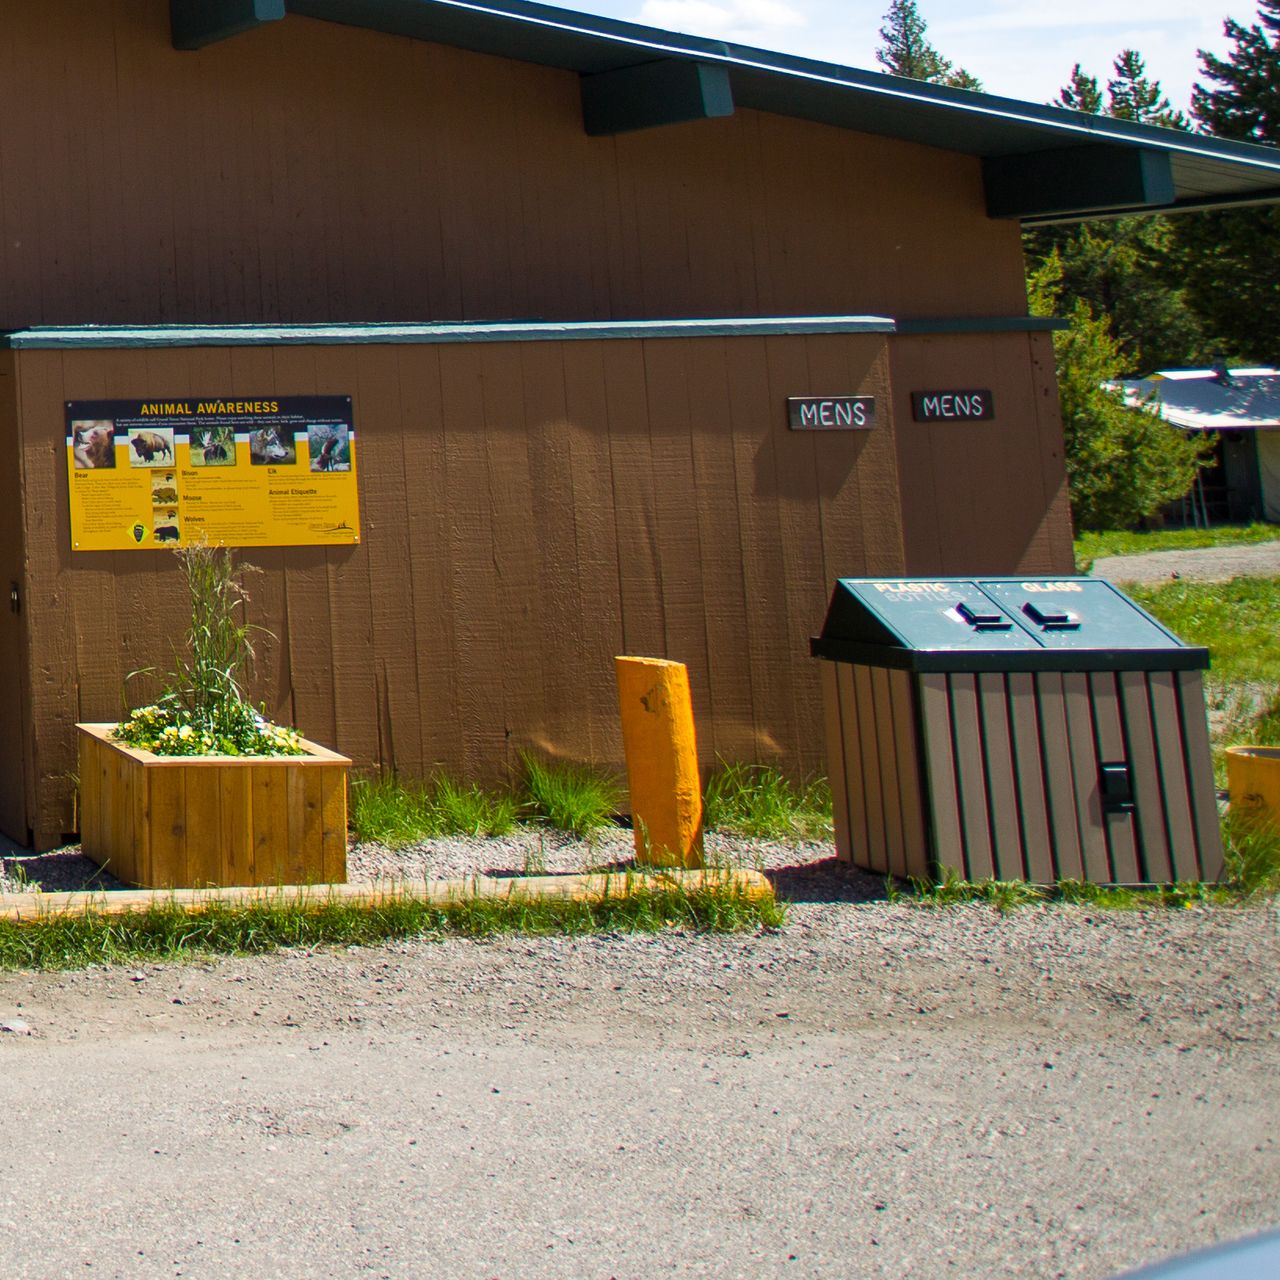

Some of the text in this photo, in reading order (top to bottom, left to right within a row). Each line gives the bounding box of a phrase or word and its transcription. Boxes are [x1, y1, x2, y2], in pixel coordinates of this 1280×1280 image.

[141, 401, 278, 415] ANIMAL AWARENESS
[923, 395, 983, 417] MENS
[800, 402, 866, 426] MENS
[873, 582, 951, 593] PLASTIC
[1020, 582, 1084, 593] GLASS
[883, 591, 967, 602] BOTTLES
